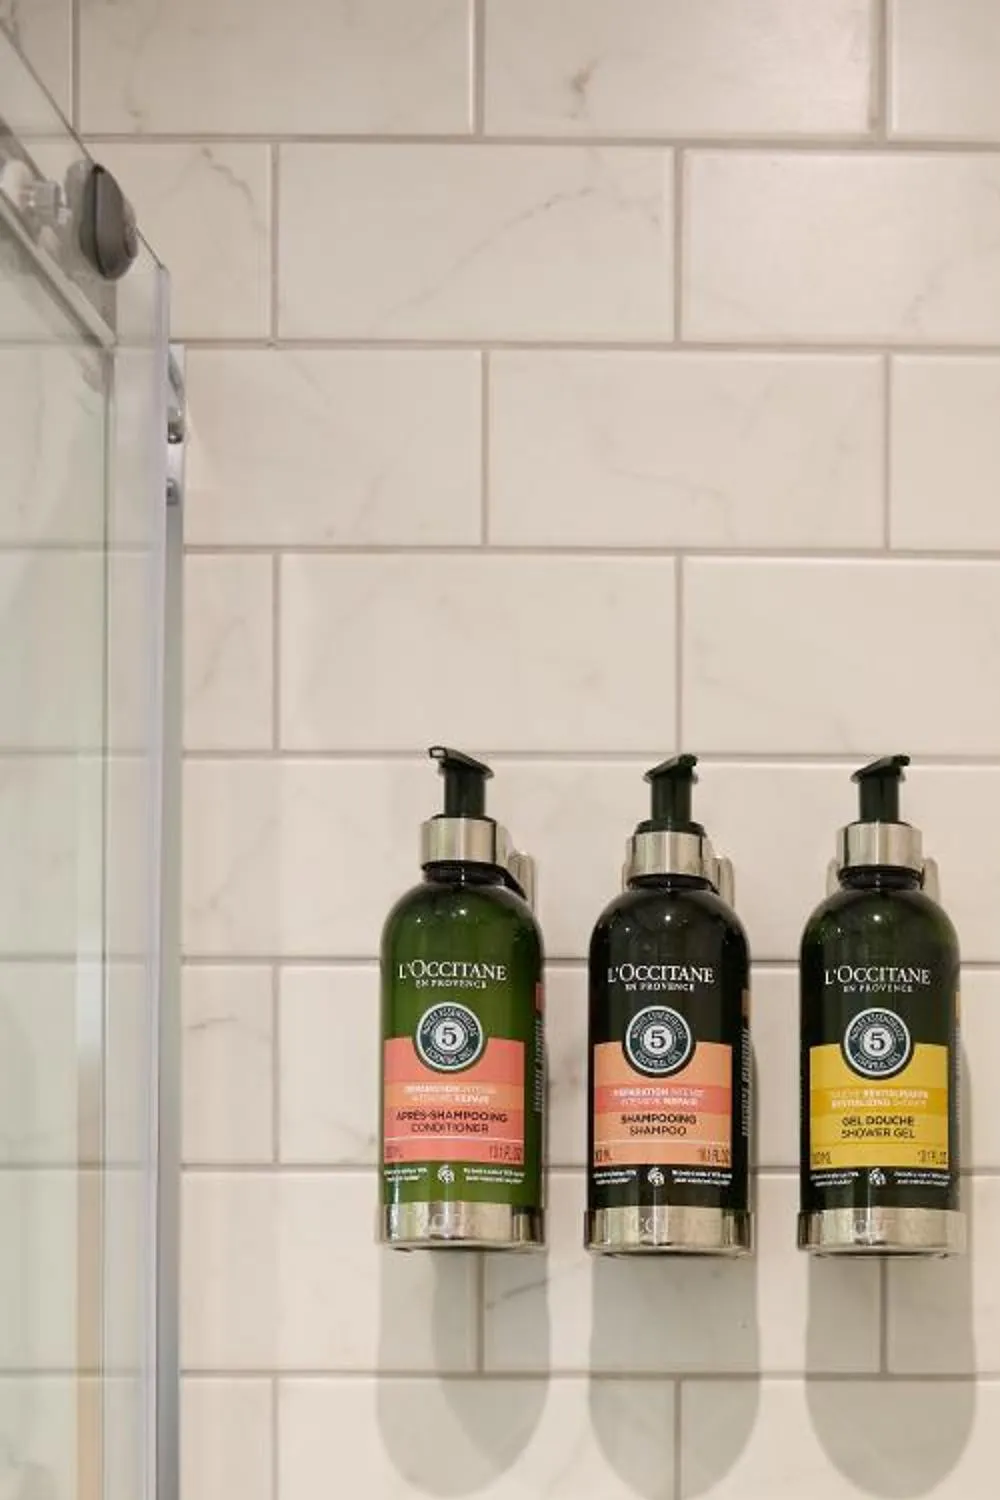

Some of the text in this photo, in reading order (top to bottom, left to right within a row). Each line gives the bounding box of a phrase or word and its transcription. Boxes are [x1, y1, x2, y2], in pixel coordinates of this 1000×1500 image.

[399, 959, 508, 981] L'OCCITANE
[607, 963, 715, 984] L'OCCITANE
[824, 965, 931, 985] L'OCCITANE
[432, 979, 487, 989] PROVENCE
[639, 983, 695, 992] PROVENCE
[859, 984, 913, 993] PROVENCE
[441, 1027, 457, 1047] 5
[650, 1029, 666, 1049] 5
[869, 1032, 885, 1051] 5
[620, 1113, 697, 1125] SHAMPOOING
[841, 1115, 915, 1127] GEL DOUCHE
[411, 1122, 489, 1133] CONDITIONER
[629, 1125, 687, 1137] SHAMPOO
[841, 1128, 916, 1139] SHOWER GEL
